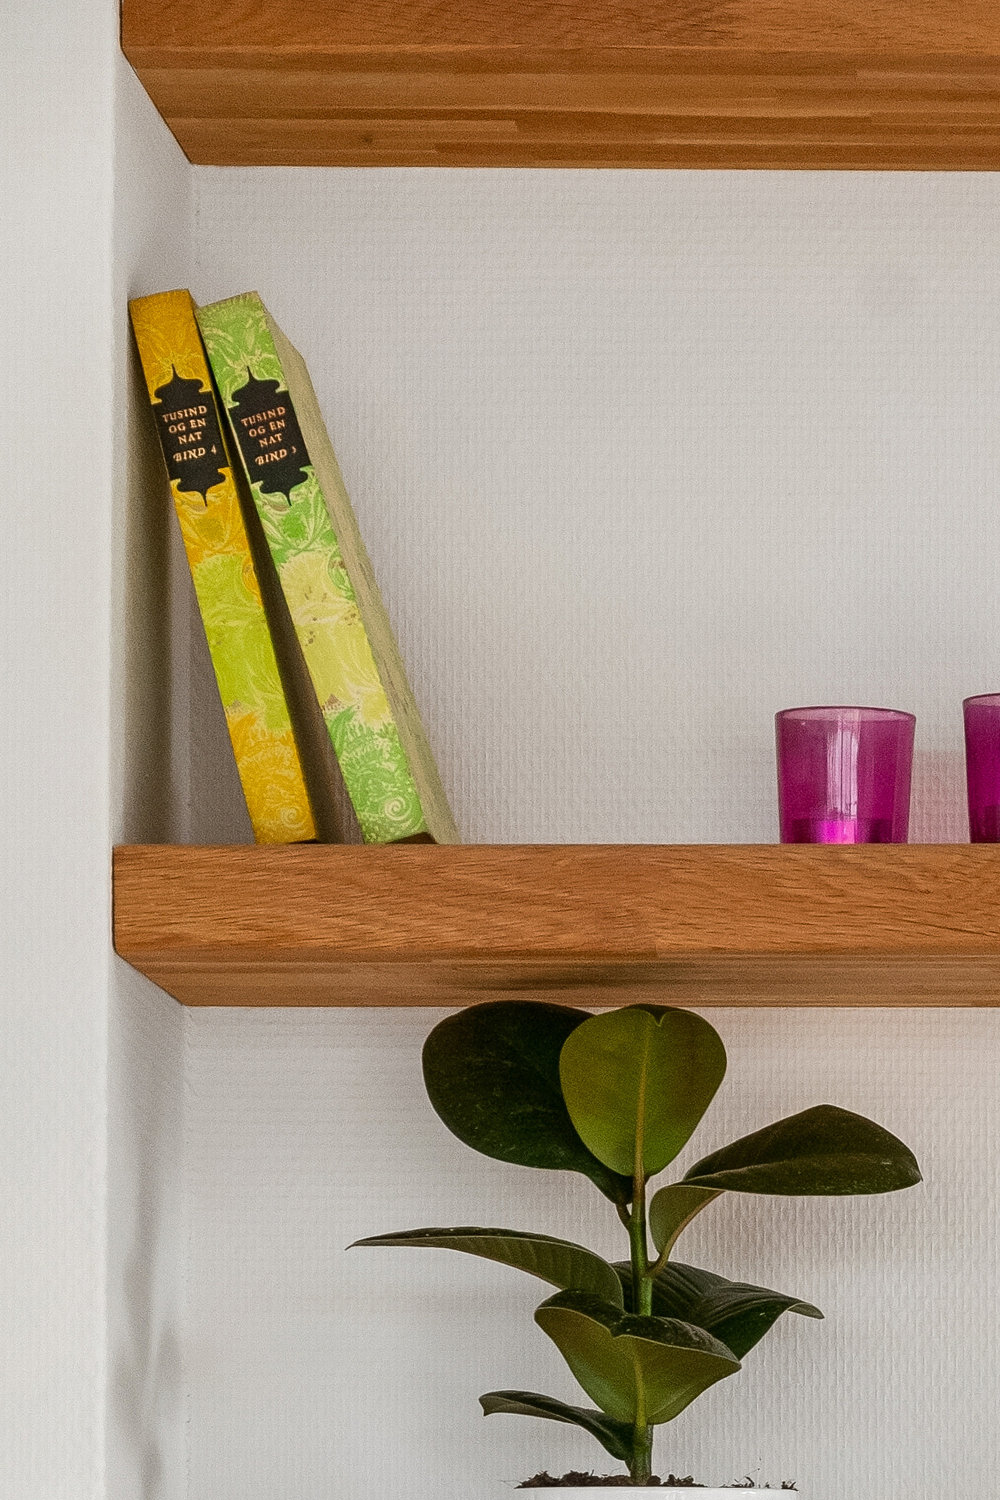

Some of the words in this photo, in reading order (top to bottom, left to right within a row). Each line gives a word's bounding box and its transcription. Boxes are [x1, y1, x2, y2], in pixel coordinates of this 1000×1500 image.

[162, 405, 208, 423] TUSIND
[240, 406, 286, 427] TUSIND
[168, 422, 186, 434] OG
[248, 427, 266, 438] OG
[178, 431, 203, 445] NAT
[258, 433, 283, 448] NAT
[172, 447, 206, 462] BIND
[210, 444, 217, 456] 4
[254, 448, 288, 466] BIND
